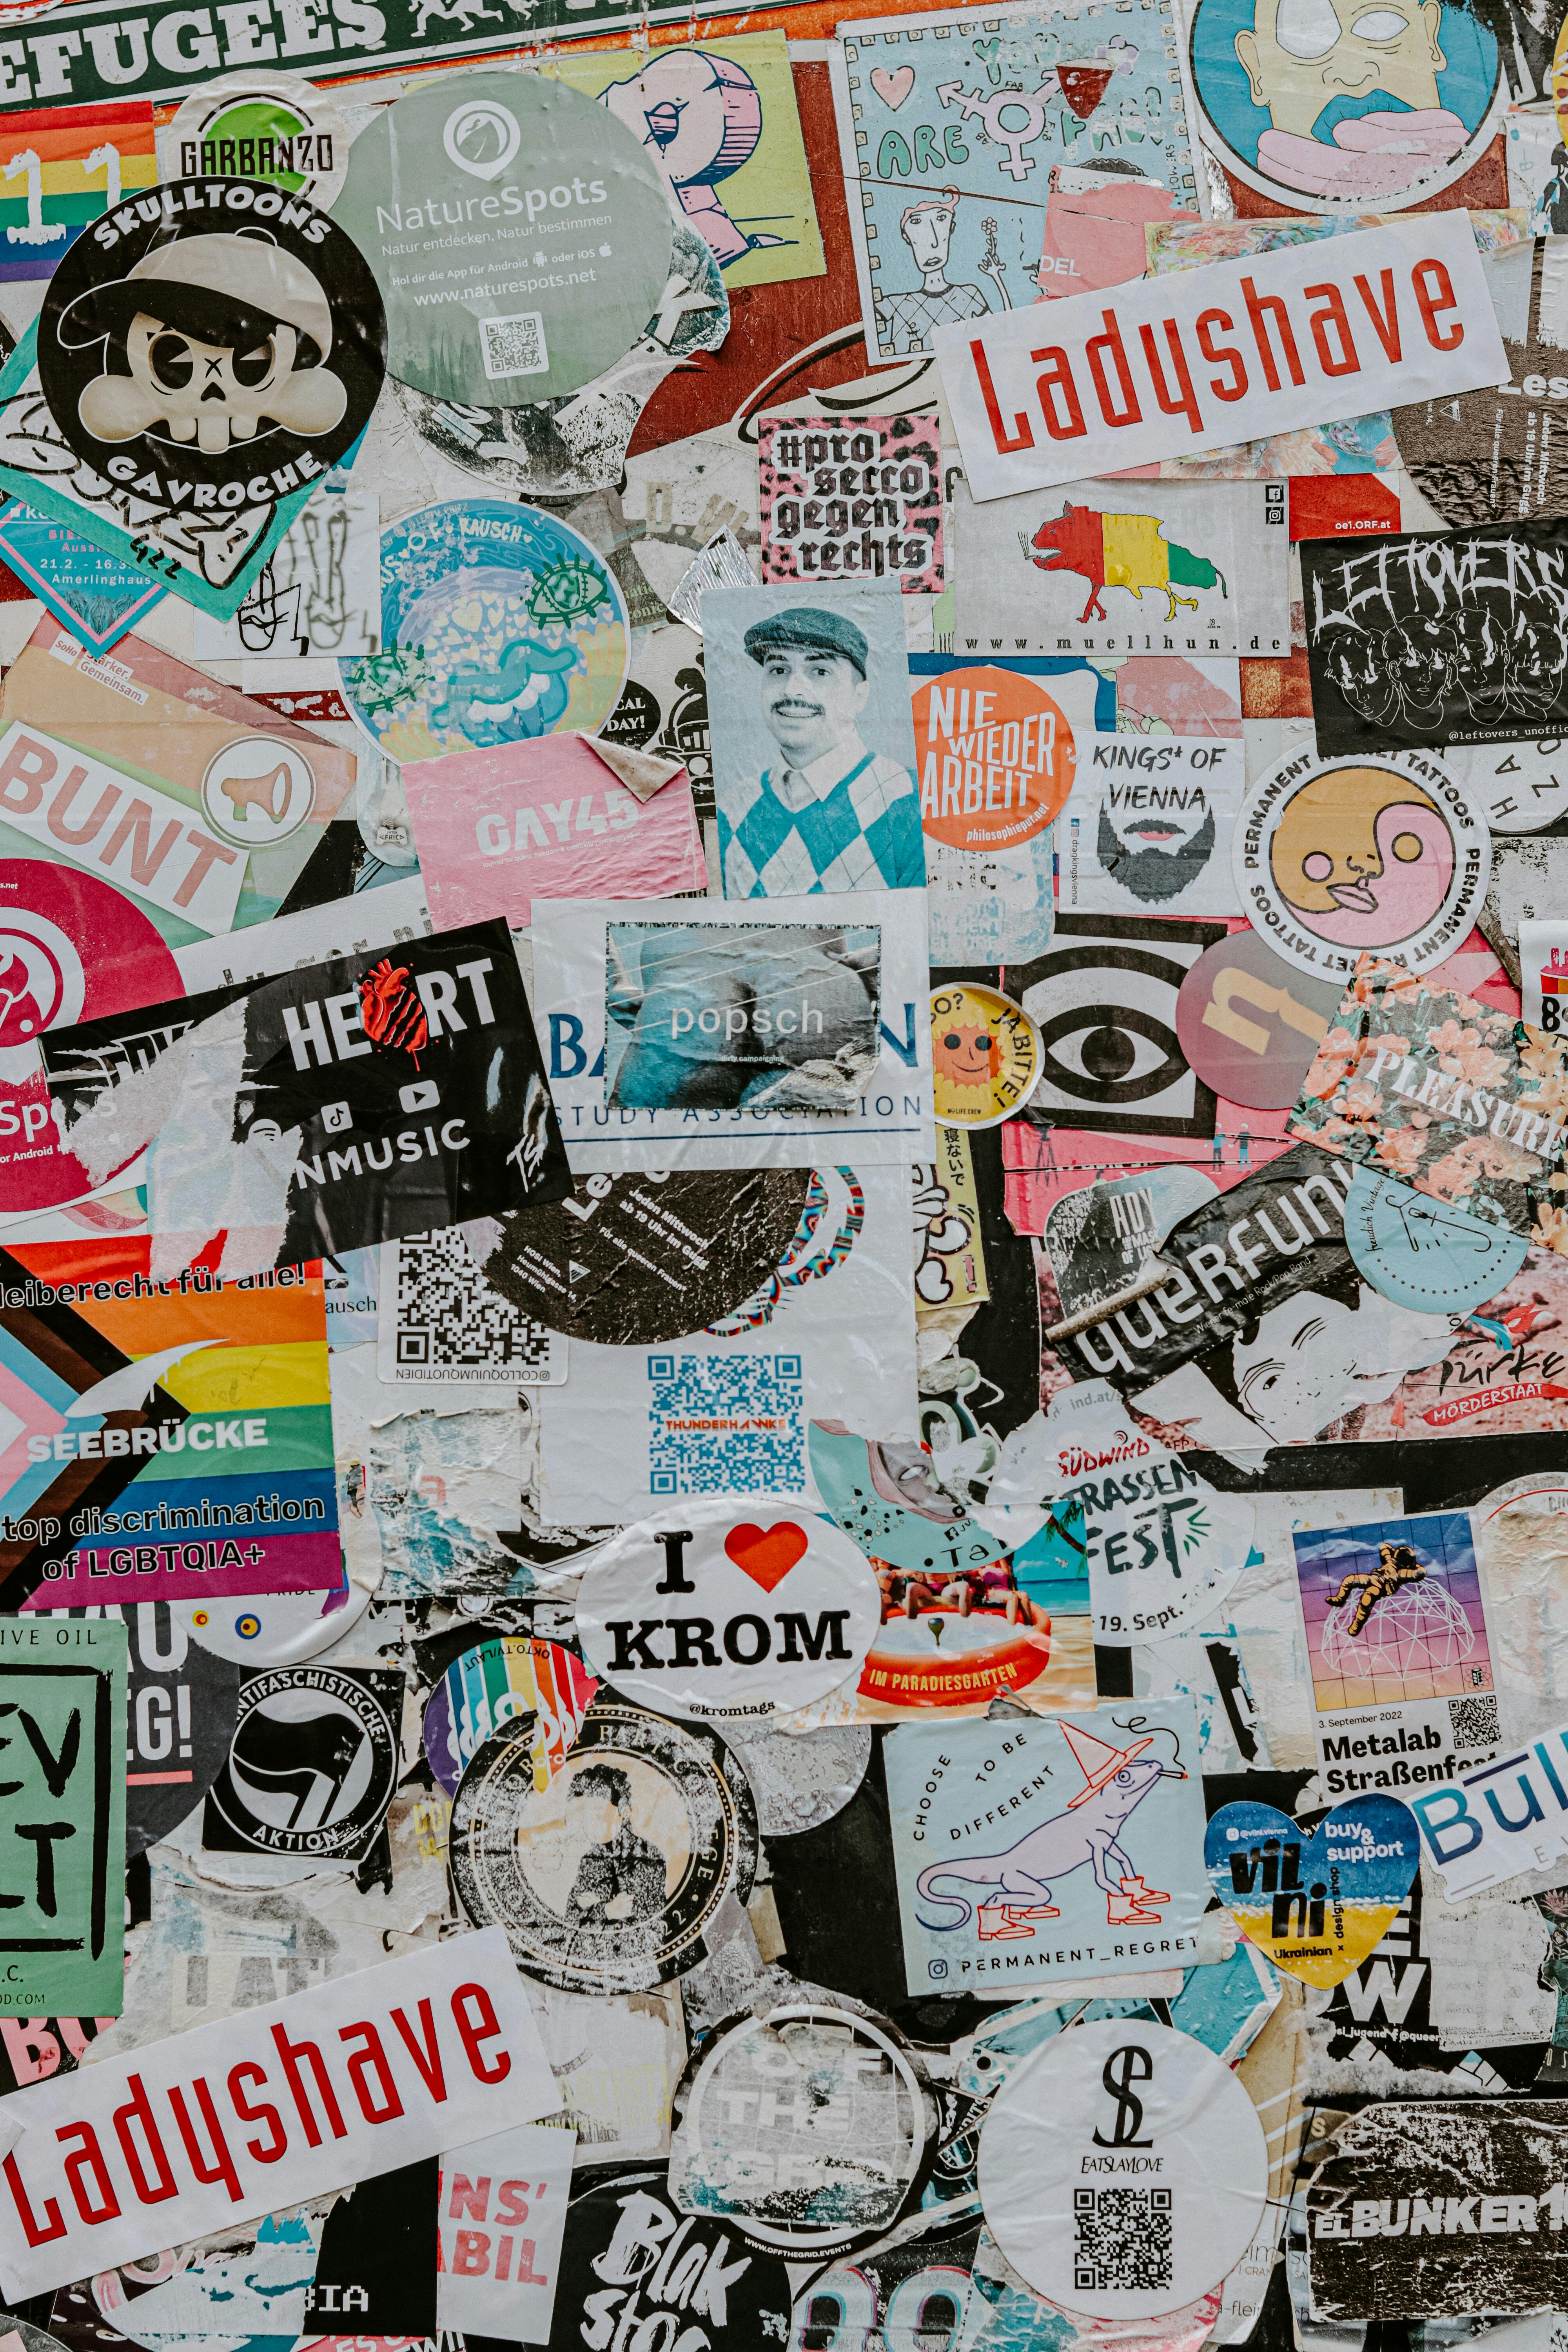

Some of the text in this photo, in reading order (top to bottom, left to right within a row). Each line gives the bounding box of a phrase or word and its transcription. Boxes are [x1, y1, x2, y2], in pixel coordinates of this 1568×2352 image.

[181, 134, 332, 177] GARBANZO
[877, 125, 969, 178] ARE
[94, 184, 332, 250] SKULLTOONS
[376, 178, 607, 233] NatureSpots
[382, 215, 612, 256] Natur entdecken, Natur bestimmen
[393, 276, 409, 285] Hol
[412, 272, 426, 283] dir
[430, 270, 444, 281] die
[447, 268, 467, 279] App
[470, 265, 484, 275] für
[488, 258, 528, 272] Android
[552, 252, 575, 263] oder
[414, 268, 597, 307] www.naturespots.net
[969, 259, 1464, 454] Ladyshave
[1494, 424, 1503, 439] alle
[777, 433, 876, 473] #pro
[1492, 441, 1500, 473] queeren
[1519, 412, 1537, 514] ab 19 Uhr im Gugg
[1537, 413, 1552, 505] Jeden Mittwoch
[107, 451, 323, 507] GAVROCHE
[813, 465, 923, 497] secco
[459, 518, 522, 543] RAUSCH
[775, 497, 904, 538] gegen
[40, 559, 77, 569] 21.2.
[798, 530, 927, 576] rechts
[52, 574, 151, 586] Amerlinghaus
[55, 640, 78, 657] SoHo
[80, 661, 143, 703] Gemeinsam.
[607, 715, 646, 732] DAY!
[929, 685, 997, 742] NIE
[948, 711, 1056, 777] WIEDER
[1191, 747, 1227, 771] OF
[922, 751, 1033, 819] ARBEIT
[1109, 784, 1206, 811] VIENNA
[1408, 753, 1474, 829] TATTOOS
[0, 734, 238, 908] BUNT
[475, 788, 638, 856] GAY45
[966, 802, 1050, 842] philosophiepur.net
[1245, 753, 1310, 868] PERMANENT
[1251, 885, 1318, 961] TATTOOS
[1416, 848, 1481, 962] PERMANENT
[671, 999, 824, 1040] popsch
[722, 1055, 784, 1064] dirty campaigning
[13, 1145, 53, 1162] Android
[944, 1128, 964, 1186] 寝ないで
[1362, 1178, 1385, 1212] Vintage
[619, 1199, 710, 1270] ab 19 Uhr im Gugg
[629, 1189, 709, 1249] Jeden Mittwoch
[524, 1245, 561, 1278] HOSI Wien,
[599, 1226, 613, 1240] Für
[612, 1236, 628, 1251] alle
[627, 1248, 659, 1272] queeren
[179, 1268, 223, 1295] für
[511, 1263, 545, 1293] 1040 Wien
[517, 1254, 567, 1294] Heumühlgasse
[1193, 1314, 1220, 1334] Wiener
[1289, 1256, 1311, 1276] Band
[1434, 1383, 1542, 1422] MÖRDERSTAAT
[27, 1419, 268, 1463] SEEBRÜCKE
[1058, 1438, 1149, 1477] SÜDWIND
[70, 1495, 324, 1537] discrimination
[42, 1542, 265, 1581] of LGBTQIA+
[654, 1531, 695, 1595] I
[56, 1630, 96, 1644] OIL
[1100, 1608, 1183, 1632] 19. Sept.
[605, 1610, 853, 1671] KROM
[870, 1663, 1018, 1691] IM PARADIESGARTEN
[690, 1701, 775, 1719] @kromtags
[1319, 1711, 1403, 1730] 3. September 2022
[1322, 1725, 1441, 1762] Metalab
[913, 1733, 1027, 1841] CHOOSE TO BE
[951, 1766, 1055, 1840] DIFFERENT
[254, 1825, 339, 1851] AKTION
[1325, 1821, 1362, 1838] buy
[1360, 1828, 1375, 1845] &
[1327, 1840, 1404, 1863] support
[1330, 1866, 1341, 1895] shop
[1332, 1899, 1344, 1938] design
[962, 1936, 1199, 1973] PERMANENT_REGRET
[1274, 1947, 1332, 1959] Ukrainian
[3, 1983, 510, 2248] Ladyshave
[744, 2236, 852, 2258] WWW.OFFTHEGRID.EVENTS
